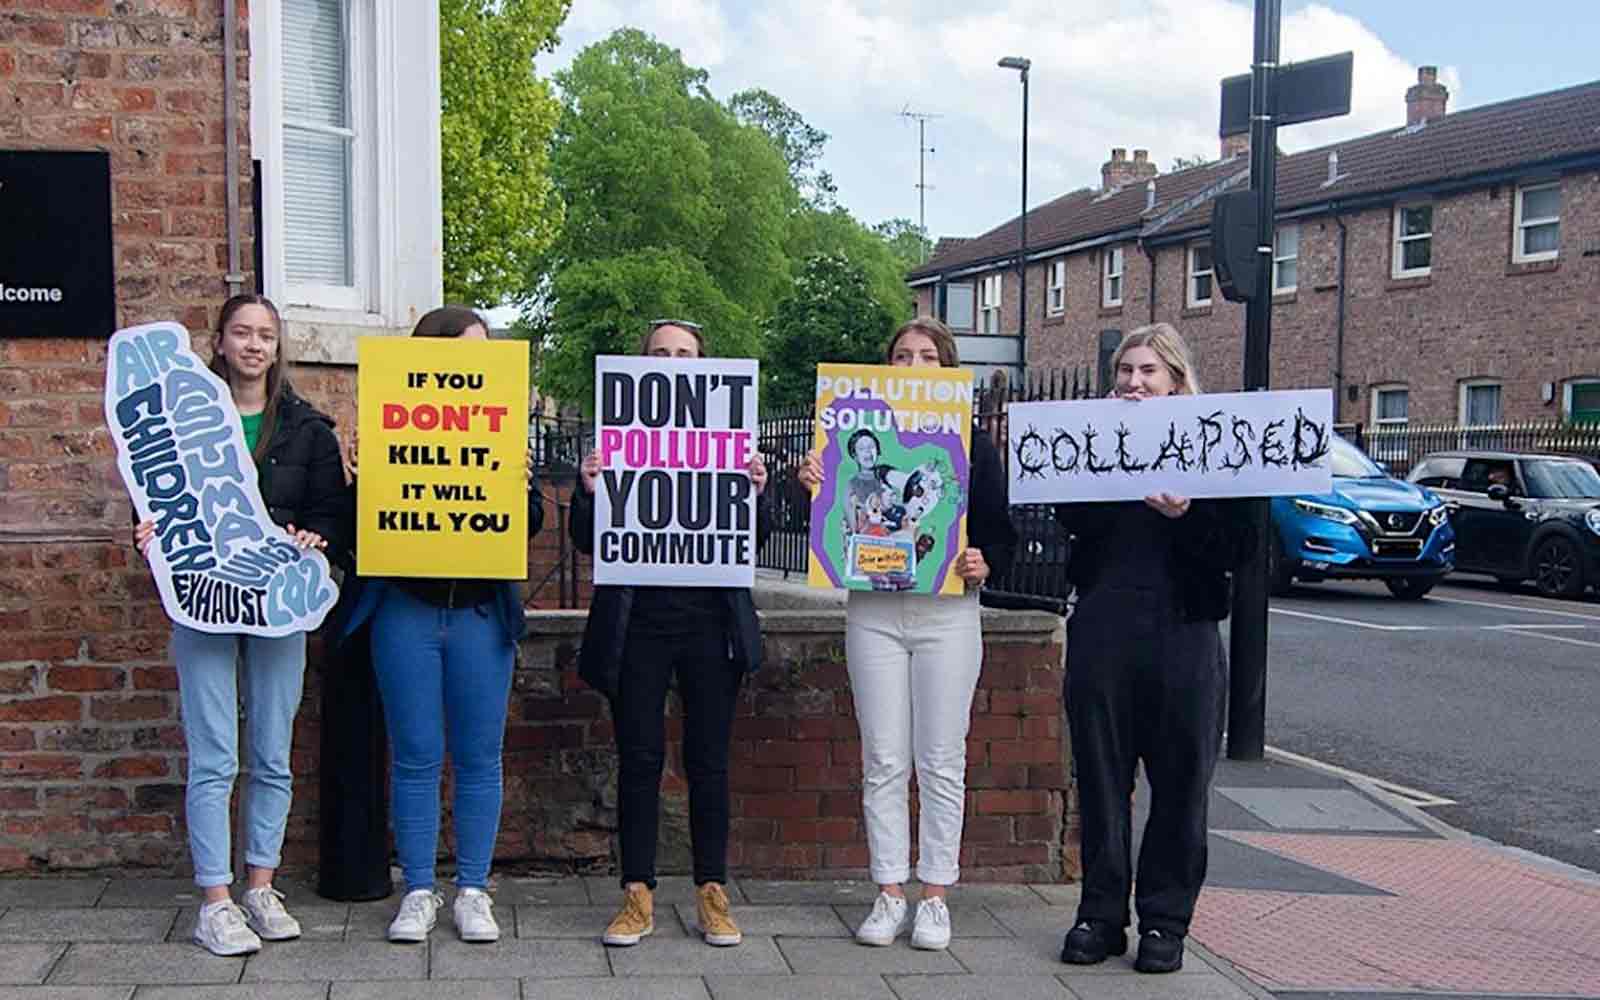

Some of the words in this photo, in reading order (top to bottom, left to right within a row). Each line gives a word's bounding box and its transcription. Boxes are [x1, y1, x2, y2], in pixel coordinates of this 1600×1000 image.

[115, 329, 194, 397] AIR
[407, 372, 428, 389] IF
[434, 373, 484, 390] YOU
[601, 372, 753, 430] DON'T
[816, 375, 973, 404] POLLUTION
[382, 404, 508, 433] DON'T
[820, 407, 961, 436] SOLUTION
[165, 369, 265, 559] ASTHMA
[388, 445, 451, 467] KILL
[460, 446, 501, 472] IT,
[601, 428, 753, 471] POLLUTE
[1011, 407, 1330, 481] COLLAPSED
[115, 382, 217, 572] CHILDREN
[402, 484, 427, 501] IT
[434, 485, 487, 502] WILL
[378, 512, 441, 532] KILL
[448, 512, 510, 534] YOU
[603, 471, 752, 531] YOUR
[207, 536, 301, 588] LUNGS
[600, 531, 750, 566] COMMUTE
[171, 572, 268, 627] EXHAUST
[267, 558, 331, 628] CO2
